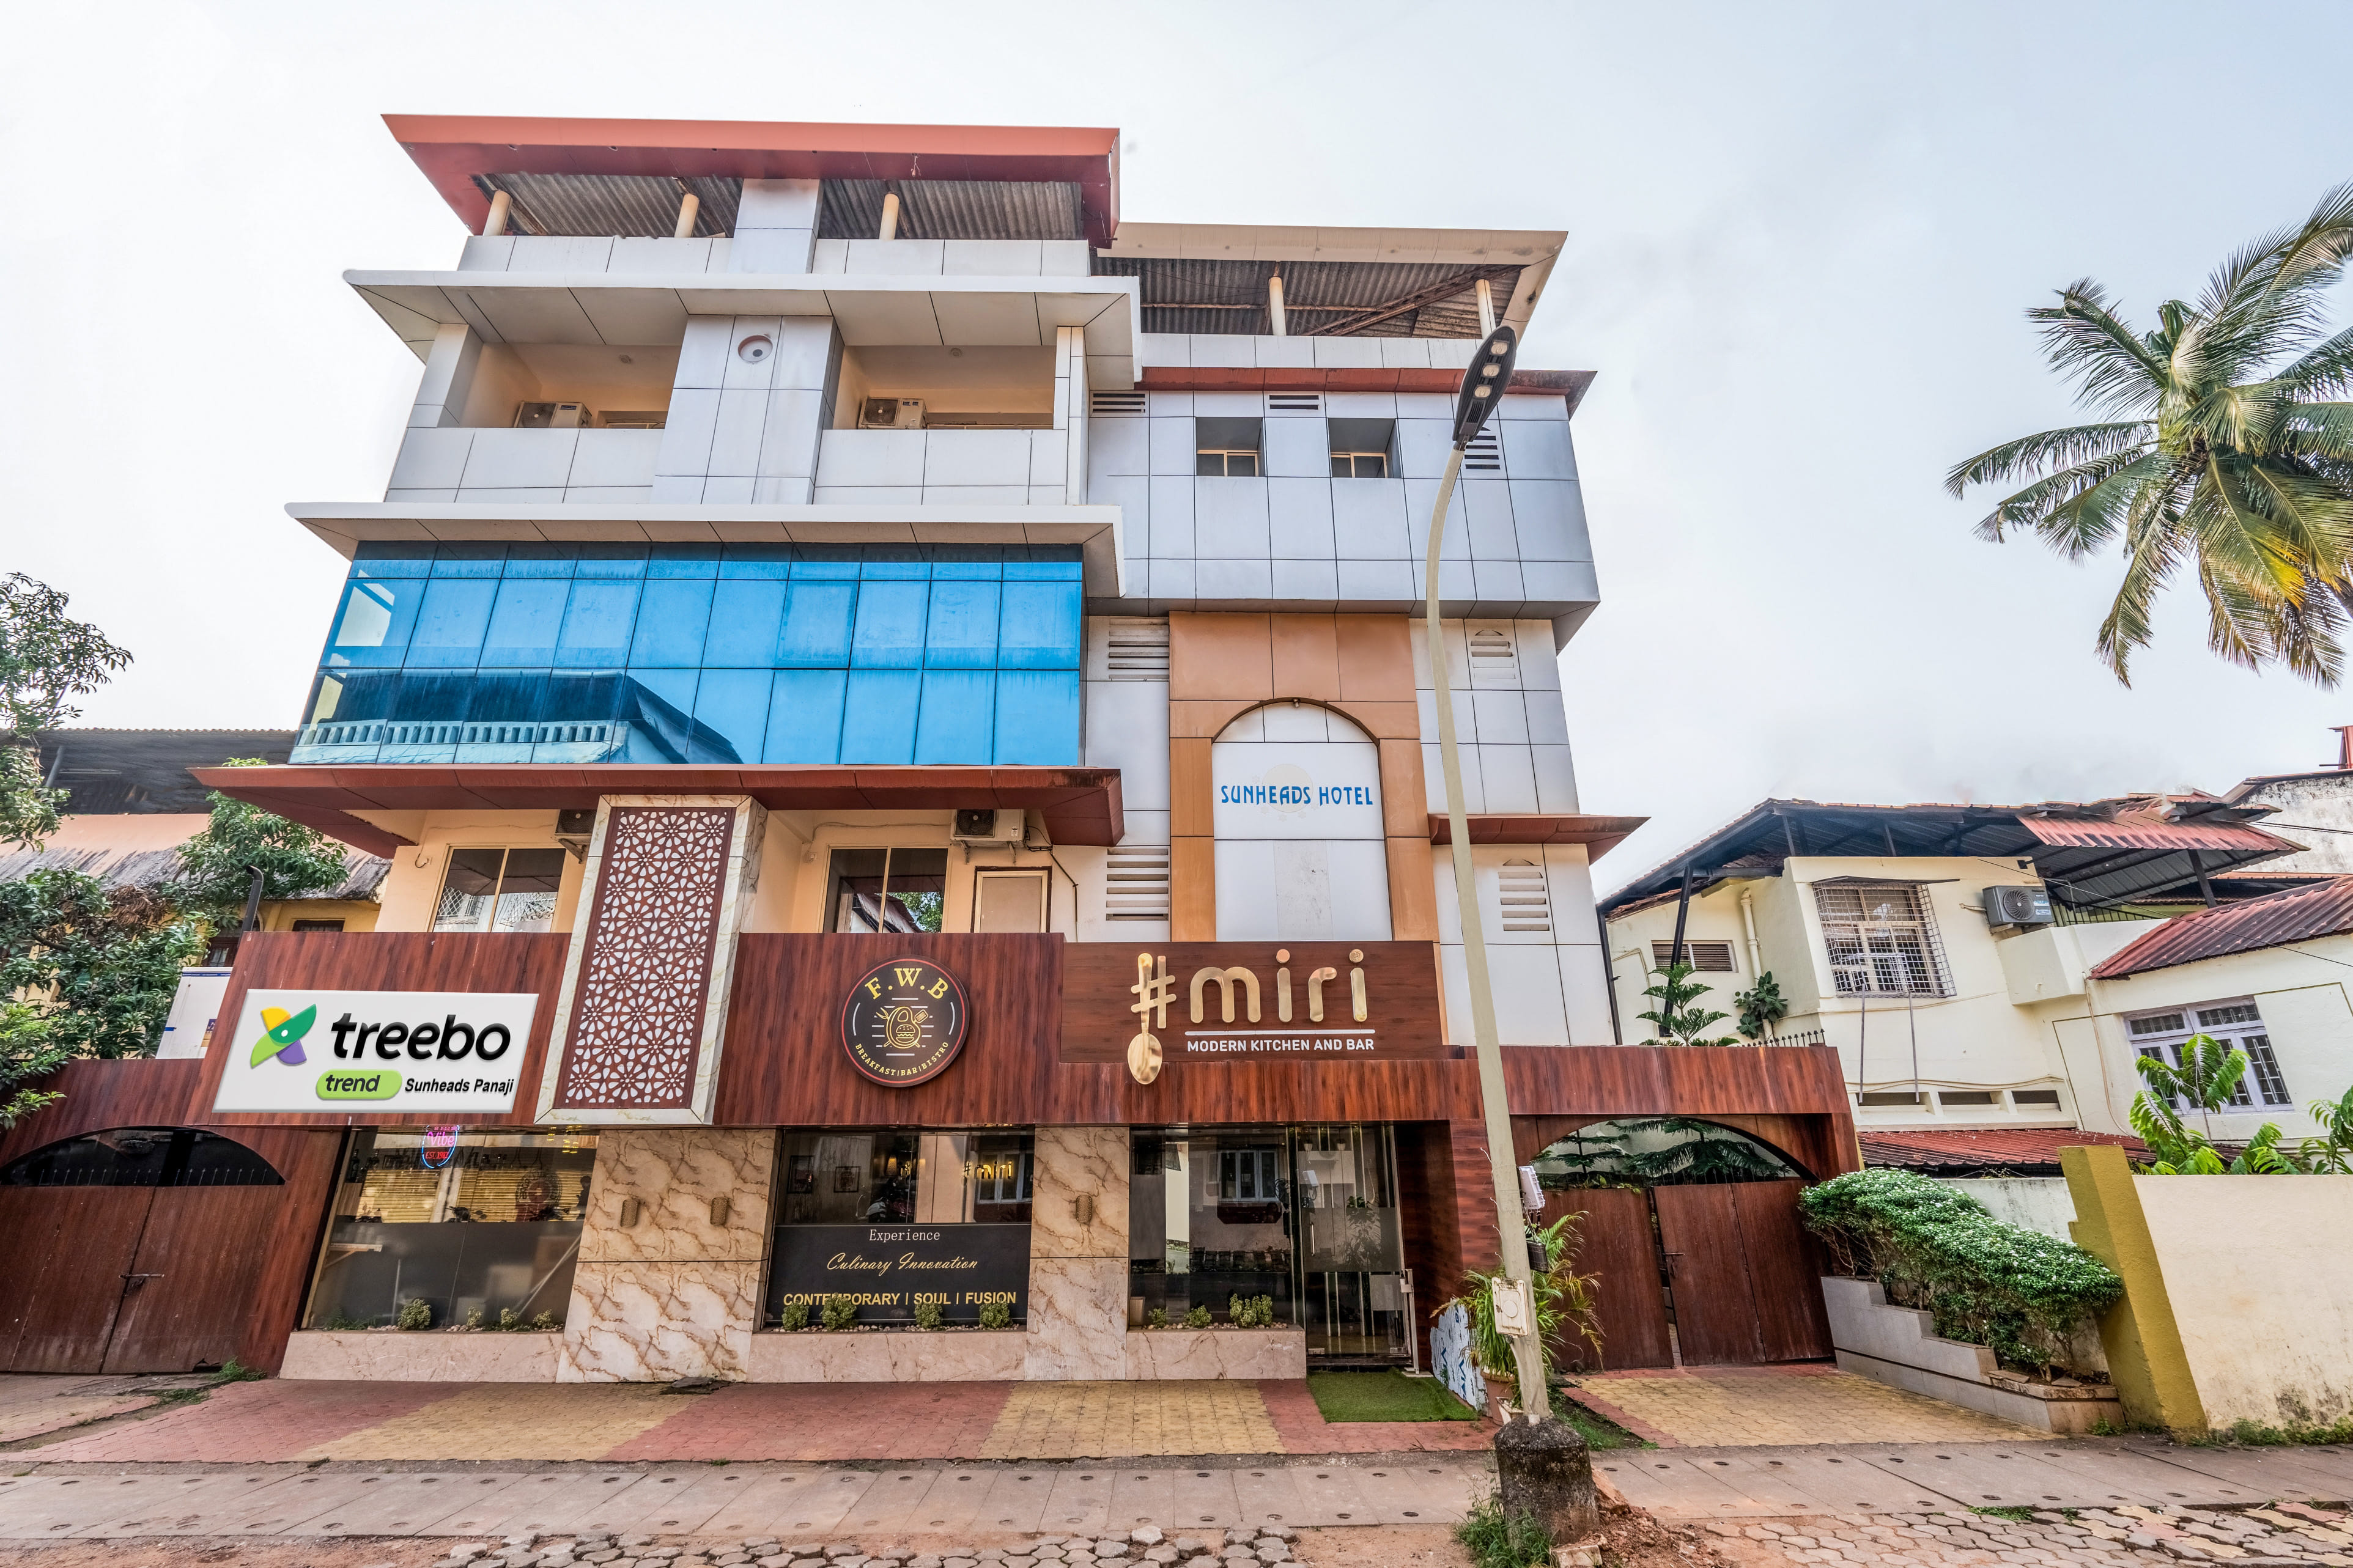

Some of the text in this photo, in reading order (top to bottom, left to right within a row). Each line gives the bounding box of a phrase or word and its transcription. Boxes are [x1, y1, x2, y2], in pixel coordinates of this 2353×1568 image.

[1221, 785, 1373, 806] SUNHEADS HOTEL
[330, 1012, 511, 1061] treebo
[1187, 1039, 1375, 1052] MODERN KITCHEN AND BAR
[325, 1074, 514, 1095] trend Sunheads Panaji
[427, 1131, 455, 1146] Vibe
[869, 1229, 940, 1243] Experience
[827, 1252, 978, 1276] Culinary Innovation
[914, 1292, 951, 1305] SOUL
[966, 1292, 1016, 1305] FUSION
